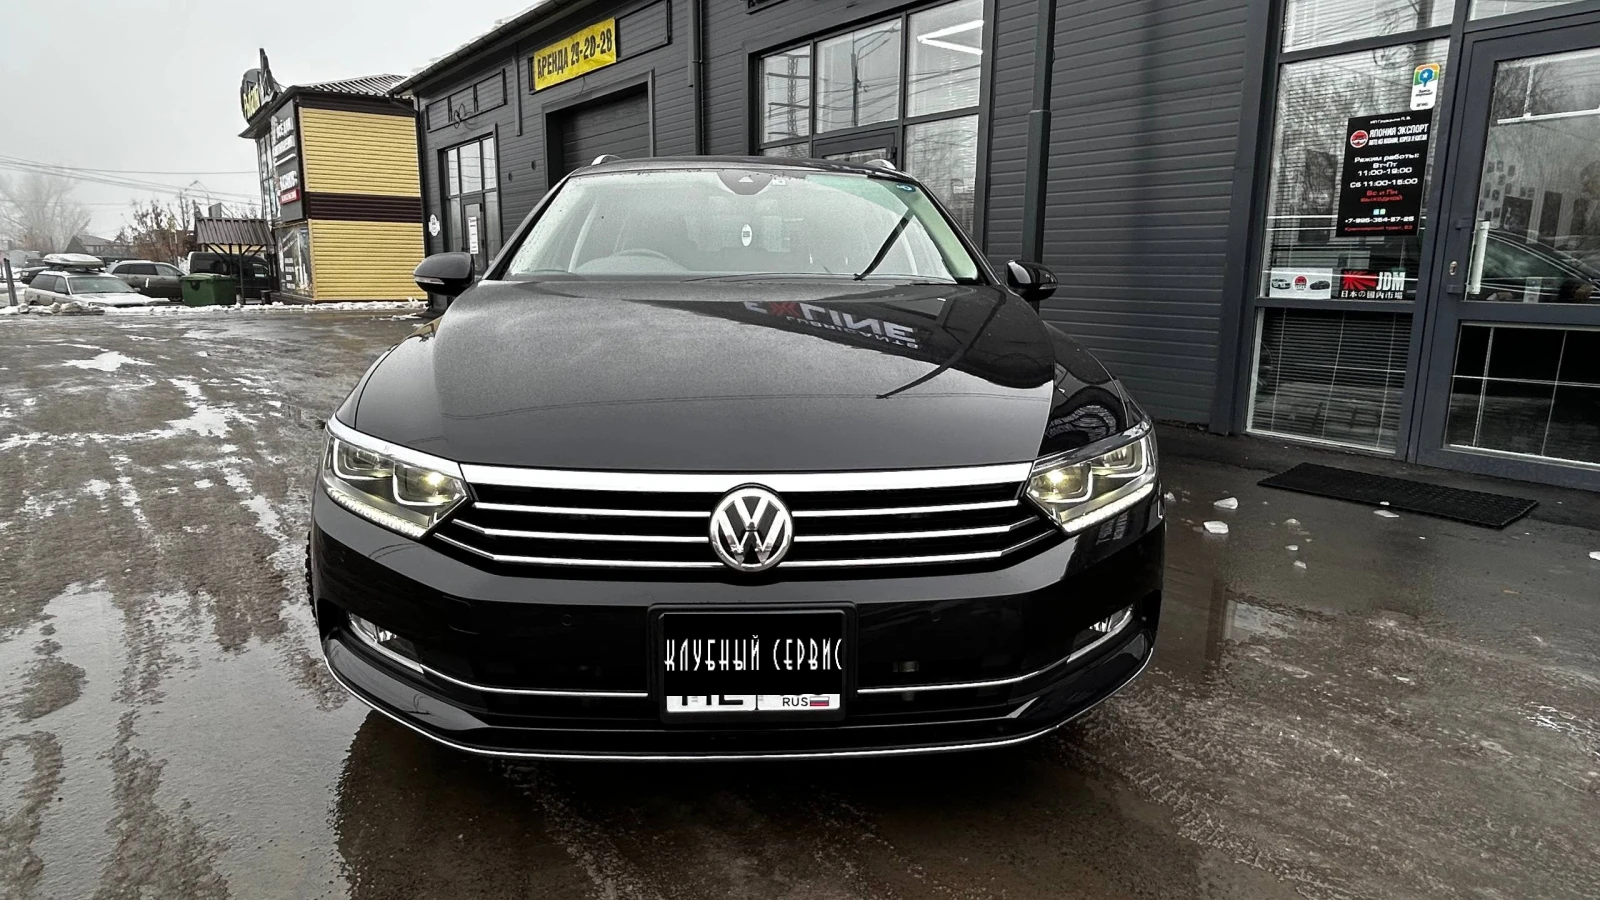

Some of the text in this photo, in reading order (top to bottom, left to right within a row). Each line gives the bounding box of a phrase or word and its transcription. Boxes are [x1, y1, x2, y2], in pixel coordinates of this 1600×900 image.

[537, 47, 568, 79] АРЕНДА
[1369, 124, 1429, 138] ЯПОНИЯ ЭКСПОРТ
[1373, 161, 1398, 169] Вт-Пт
[1376, 271, 1406, 291] JDM
[782, 696, 809, 707] RUS
